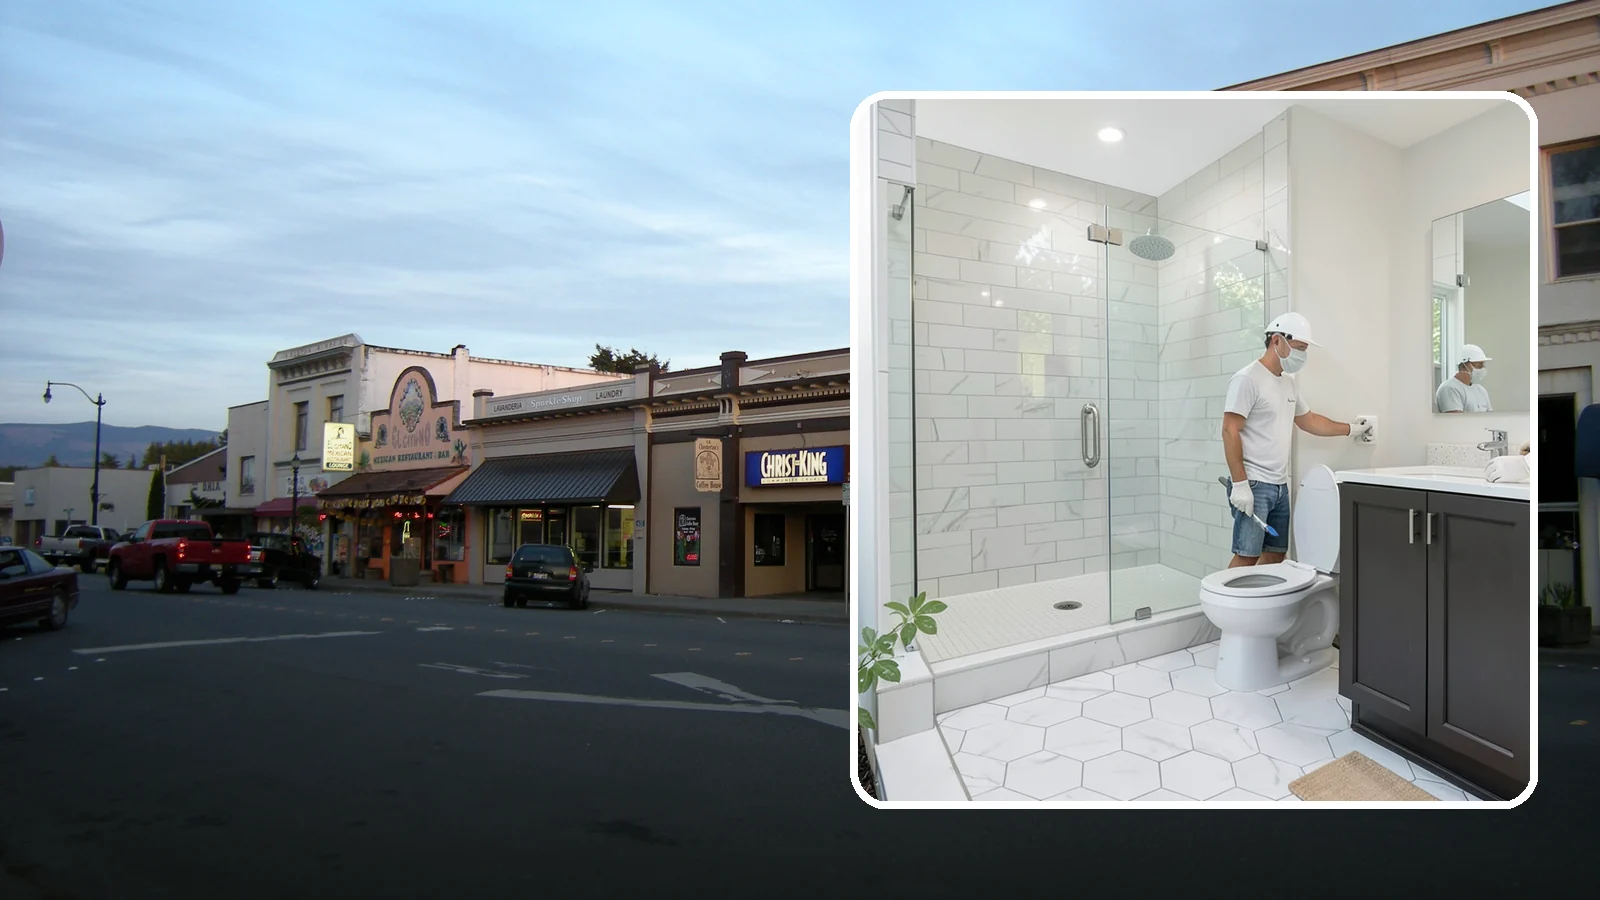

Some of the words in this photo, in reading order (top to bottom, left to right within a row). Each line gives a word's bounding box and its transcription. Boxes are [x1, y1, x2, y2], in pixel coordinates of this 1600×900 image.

[595, 389, 623, 399] LAUNDRY
[493, 402, 522, 412] LAVANDERIA
[531, 396, 561, 408] Sparkle
[561, 394, 582, 404] Shop
[373, 455, 396, 464] MEXICAN
[397, 451, 433, 462] RESTAURANT
[438, 450, 450, 459] BAR
[760, 452, 797, 478] CHRIST
[799, 450, 827, 476] KING
[696, 480, 709, 488] Coffee
[710, 480, 722, 488] House
